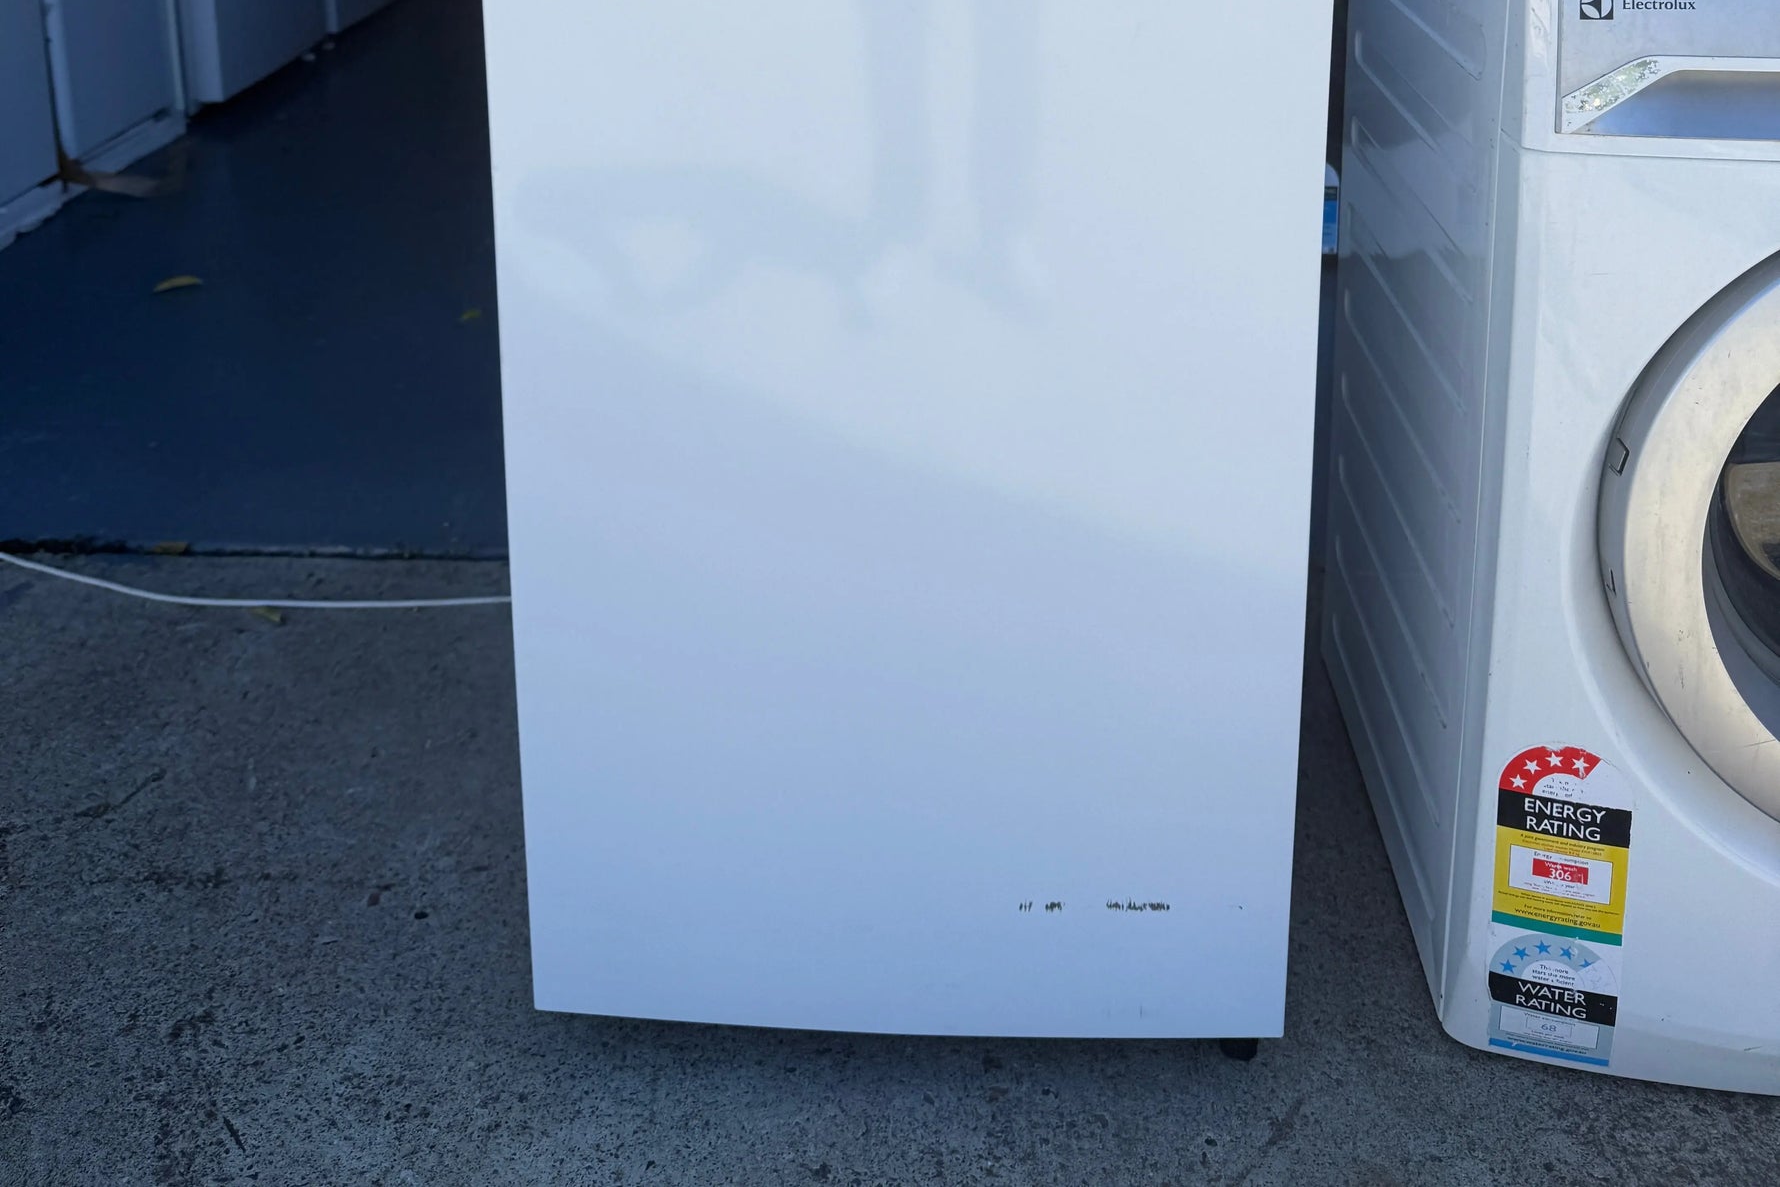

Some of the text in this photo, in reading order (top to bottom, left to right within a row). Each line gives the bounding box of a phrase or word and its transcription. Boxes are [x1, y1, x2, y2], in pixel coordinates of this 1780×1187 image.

[1524, 797, 1606, 824] ENERGY
[1526, 816, 1600, 841] RATING
[1549, 869, 1571, 881] 306
[1518, 981, 1586, 1005] WATER
[1516, 994, 1587, 1019] RATING
[1541, 1024, 1557, 1032] 68
